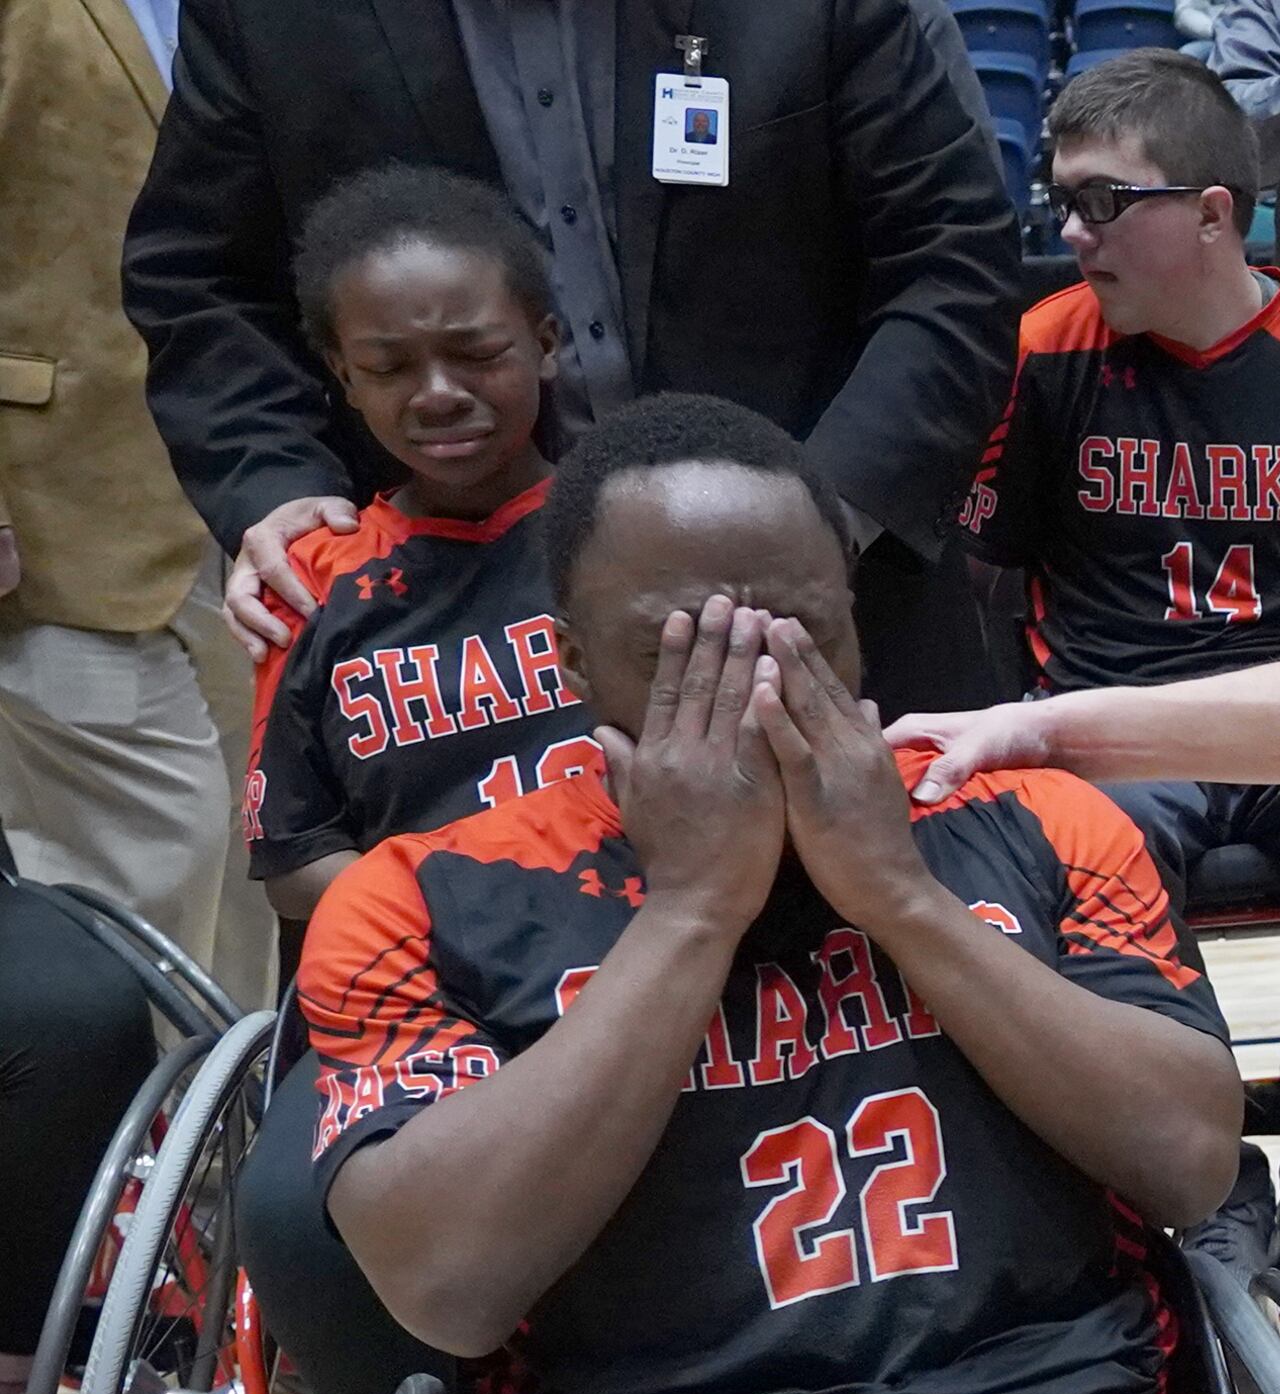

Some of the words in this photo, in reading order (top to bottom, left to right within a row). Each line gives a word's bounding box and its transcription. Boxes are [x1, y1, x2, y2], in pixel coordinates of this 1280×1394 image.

[1161, 541, 1263, 625] 14
[331, 613, 584, 760] SHAR
[740, 1086, 960, 1310] 22
